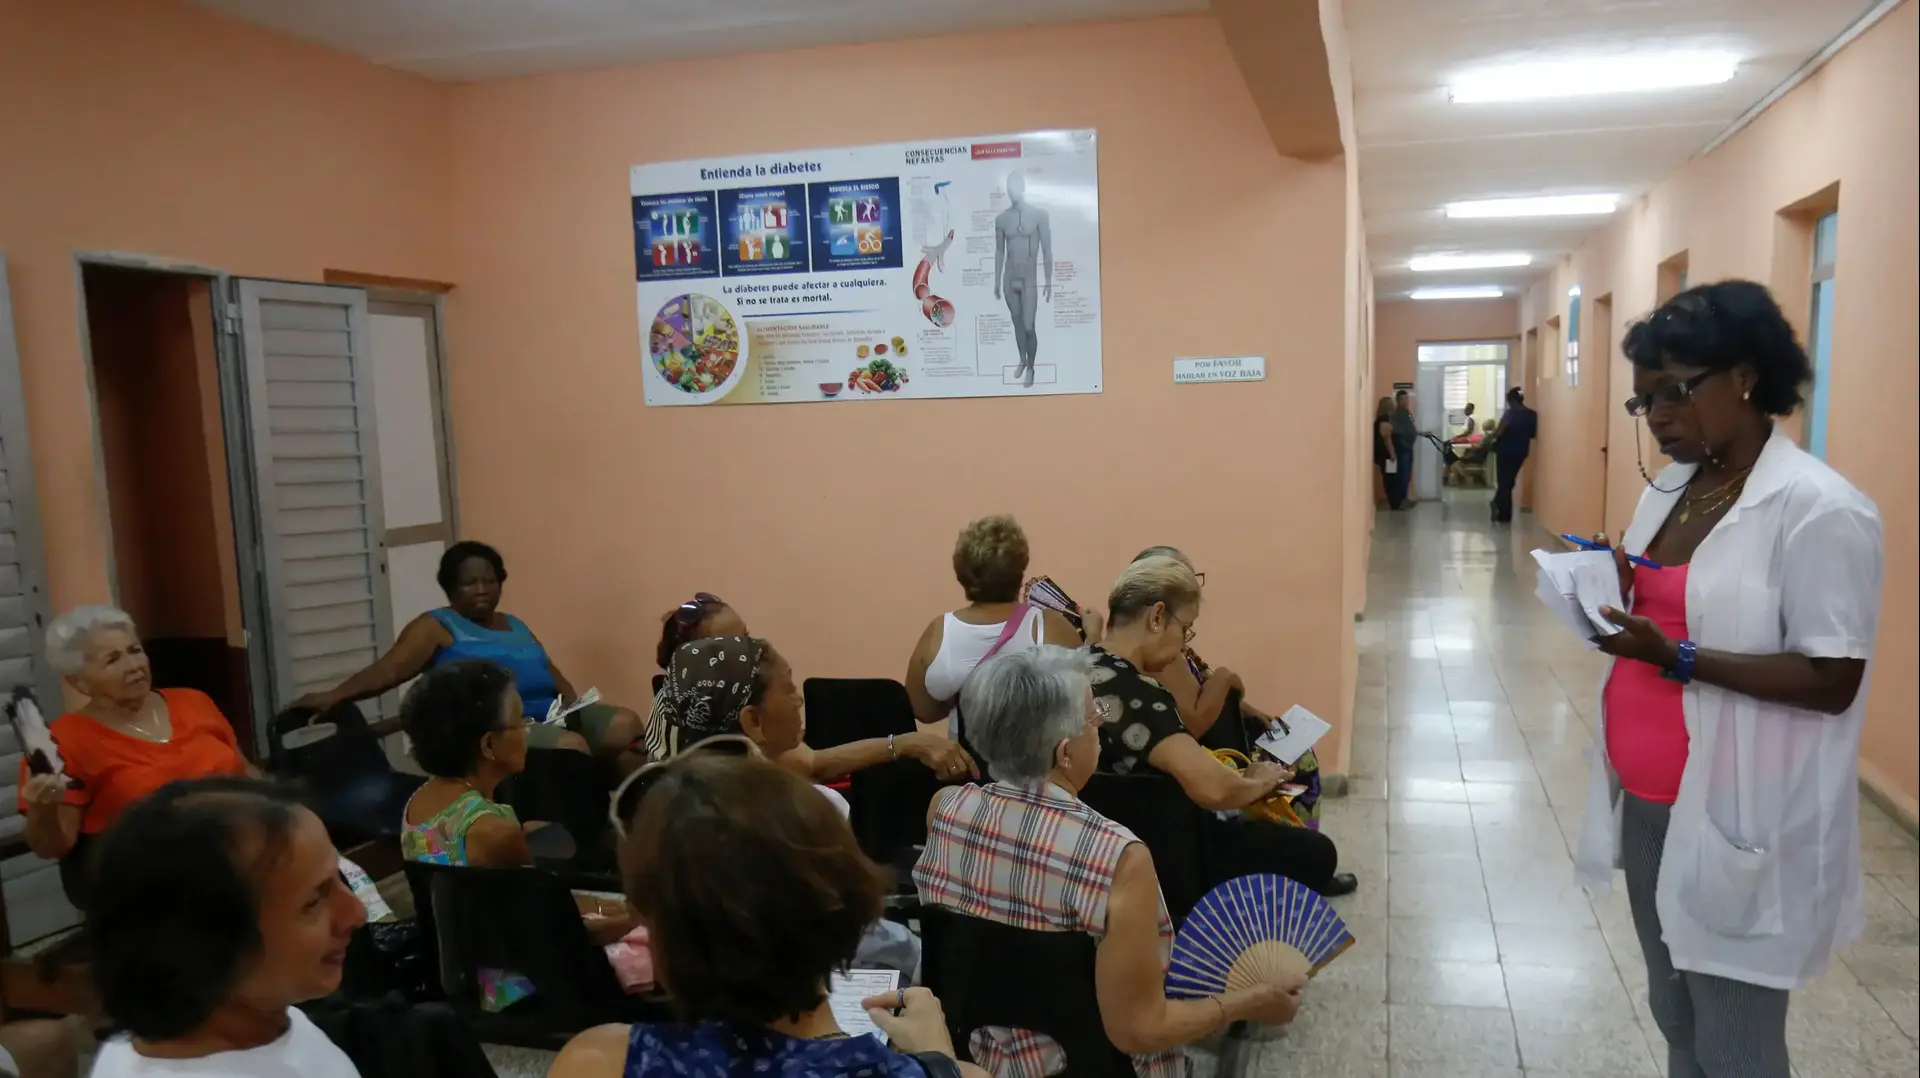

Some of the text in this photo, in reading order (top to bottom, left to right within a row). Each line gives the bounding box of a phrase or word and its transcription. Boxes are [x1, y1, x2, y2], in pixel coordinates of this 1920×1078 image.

[905, 147, 967, 158] CONSECUENCIAS
[905, 156, 945, 165] NEFASTAS
[701, 161, 822, 180] Entienda la diabetes
[723, 285, 732, 294] La
[735, 284, 770, 294] diabetes
[772, 282, 799, 293] puede
[801, 280, 830, 290] afectar
[840, 278, 887, 289] cualquiera.
[736, 297, 744, 306] Si
[759, 297, 767, 305] se
[770, 296, 789, 304] trata
[803, 293, 832, 303] mortal.
[1213, 359, 1242, 368] FAVOR
[1239, 368, 1261, 377] BAJA
